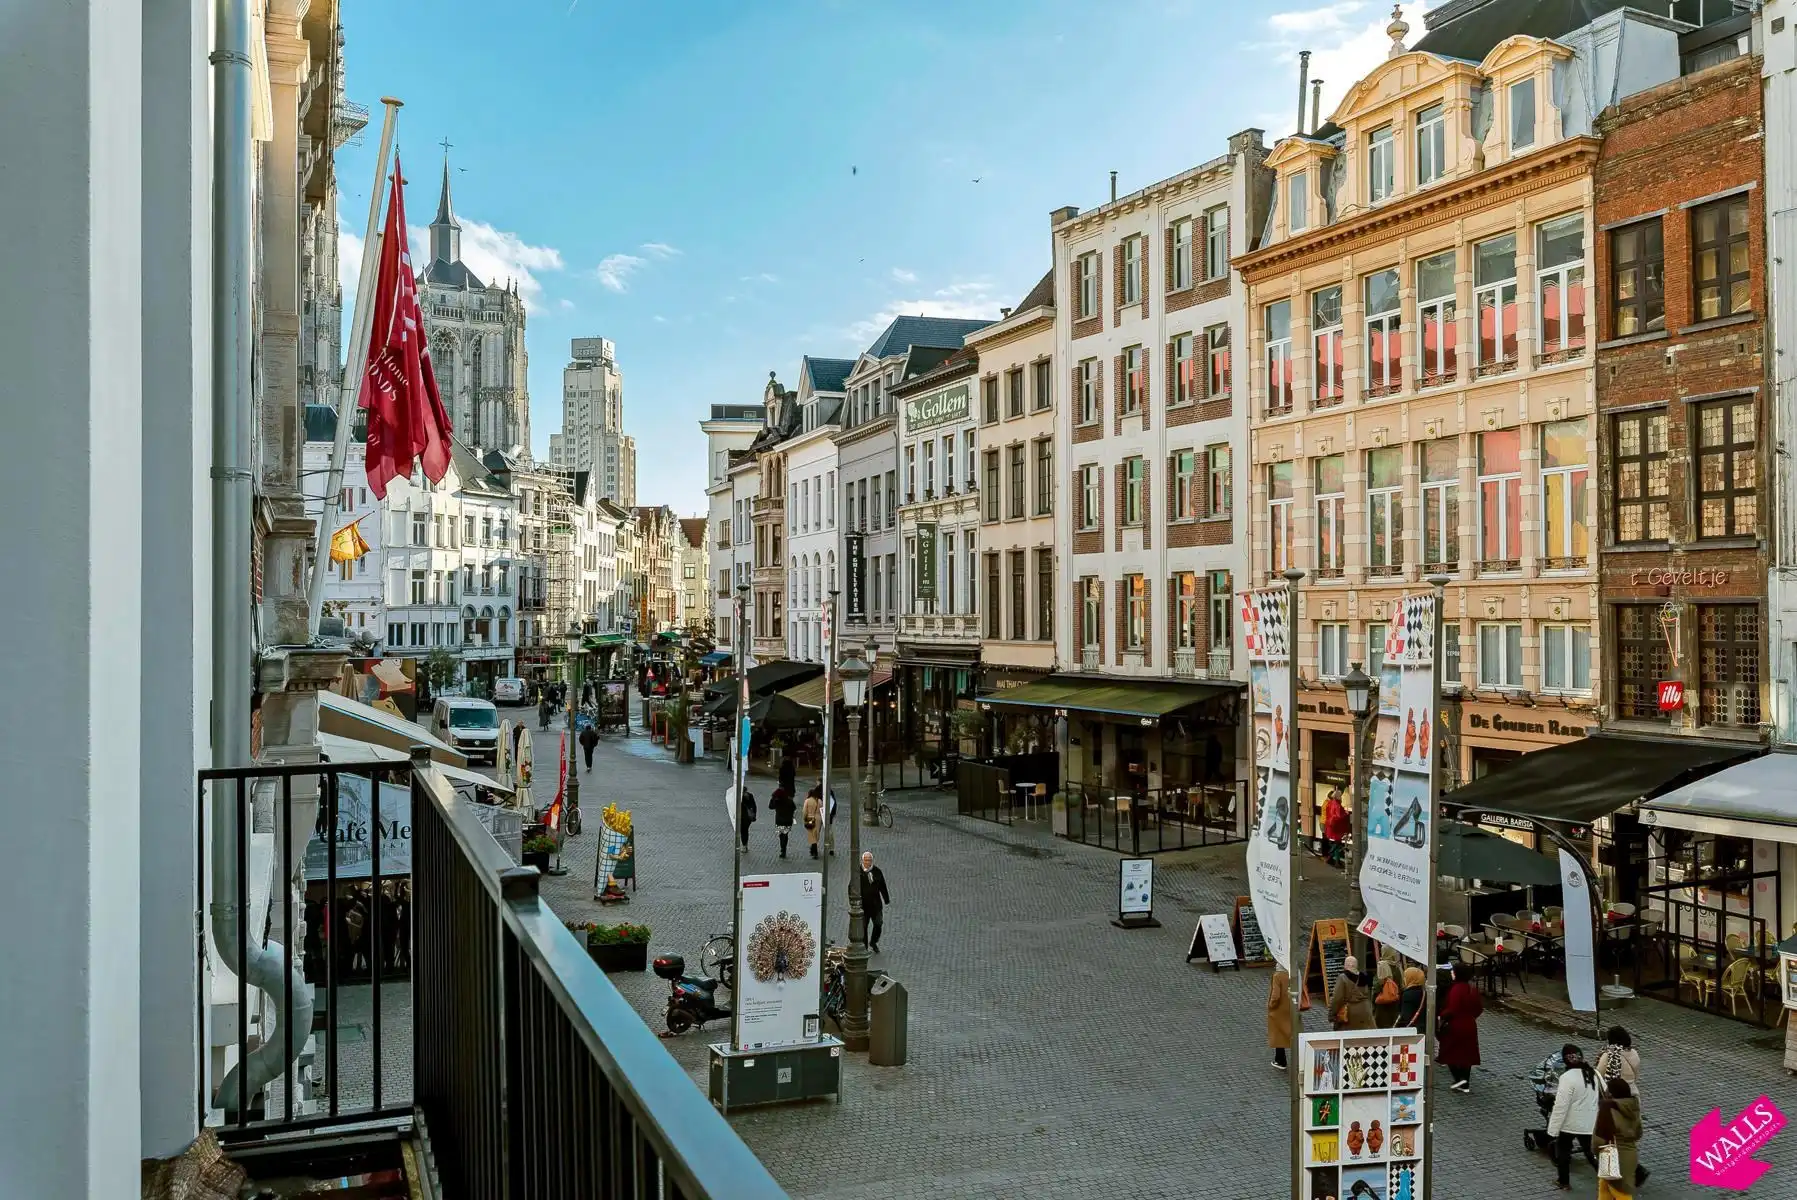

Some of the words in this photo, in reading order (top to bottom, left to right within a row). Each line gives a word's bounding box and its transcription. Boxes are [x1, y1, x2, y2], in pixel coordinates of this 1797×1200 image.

[921, 391, 966, 420] Gollem
[1648, 567, 1726, 588] Geveltje
[1661, 684, 1682, 707] illy
[1481, 813, 1508, 825] GALLERIA
[1510, 818, 1534, 828] BARISTA
